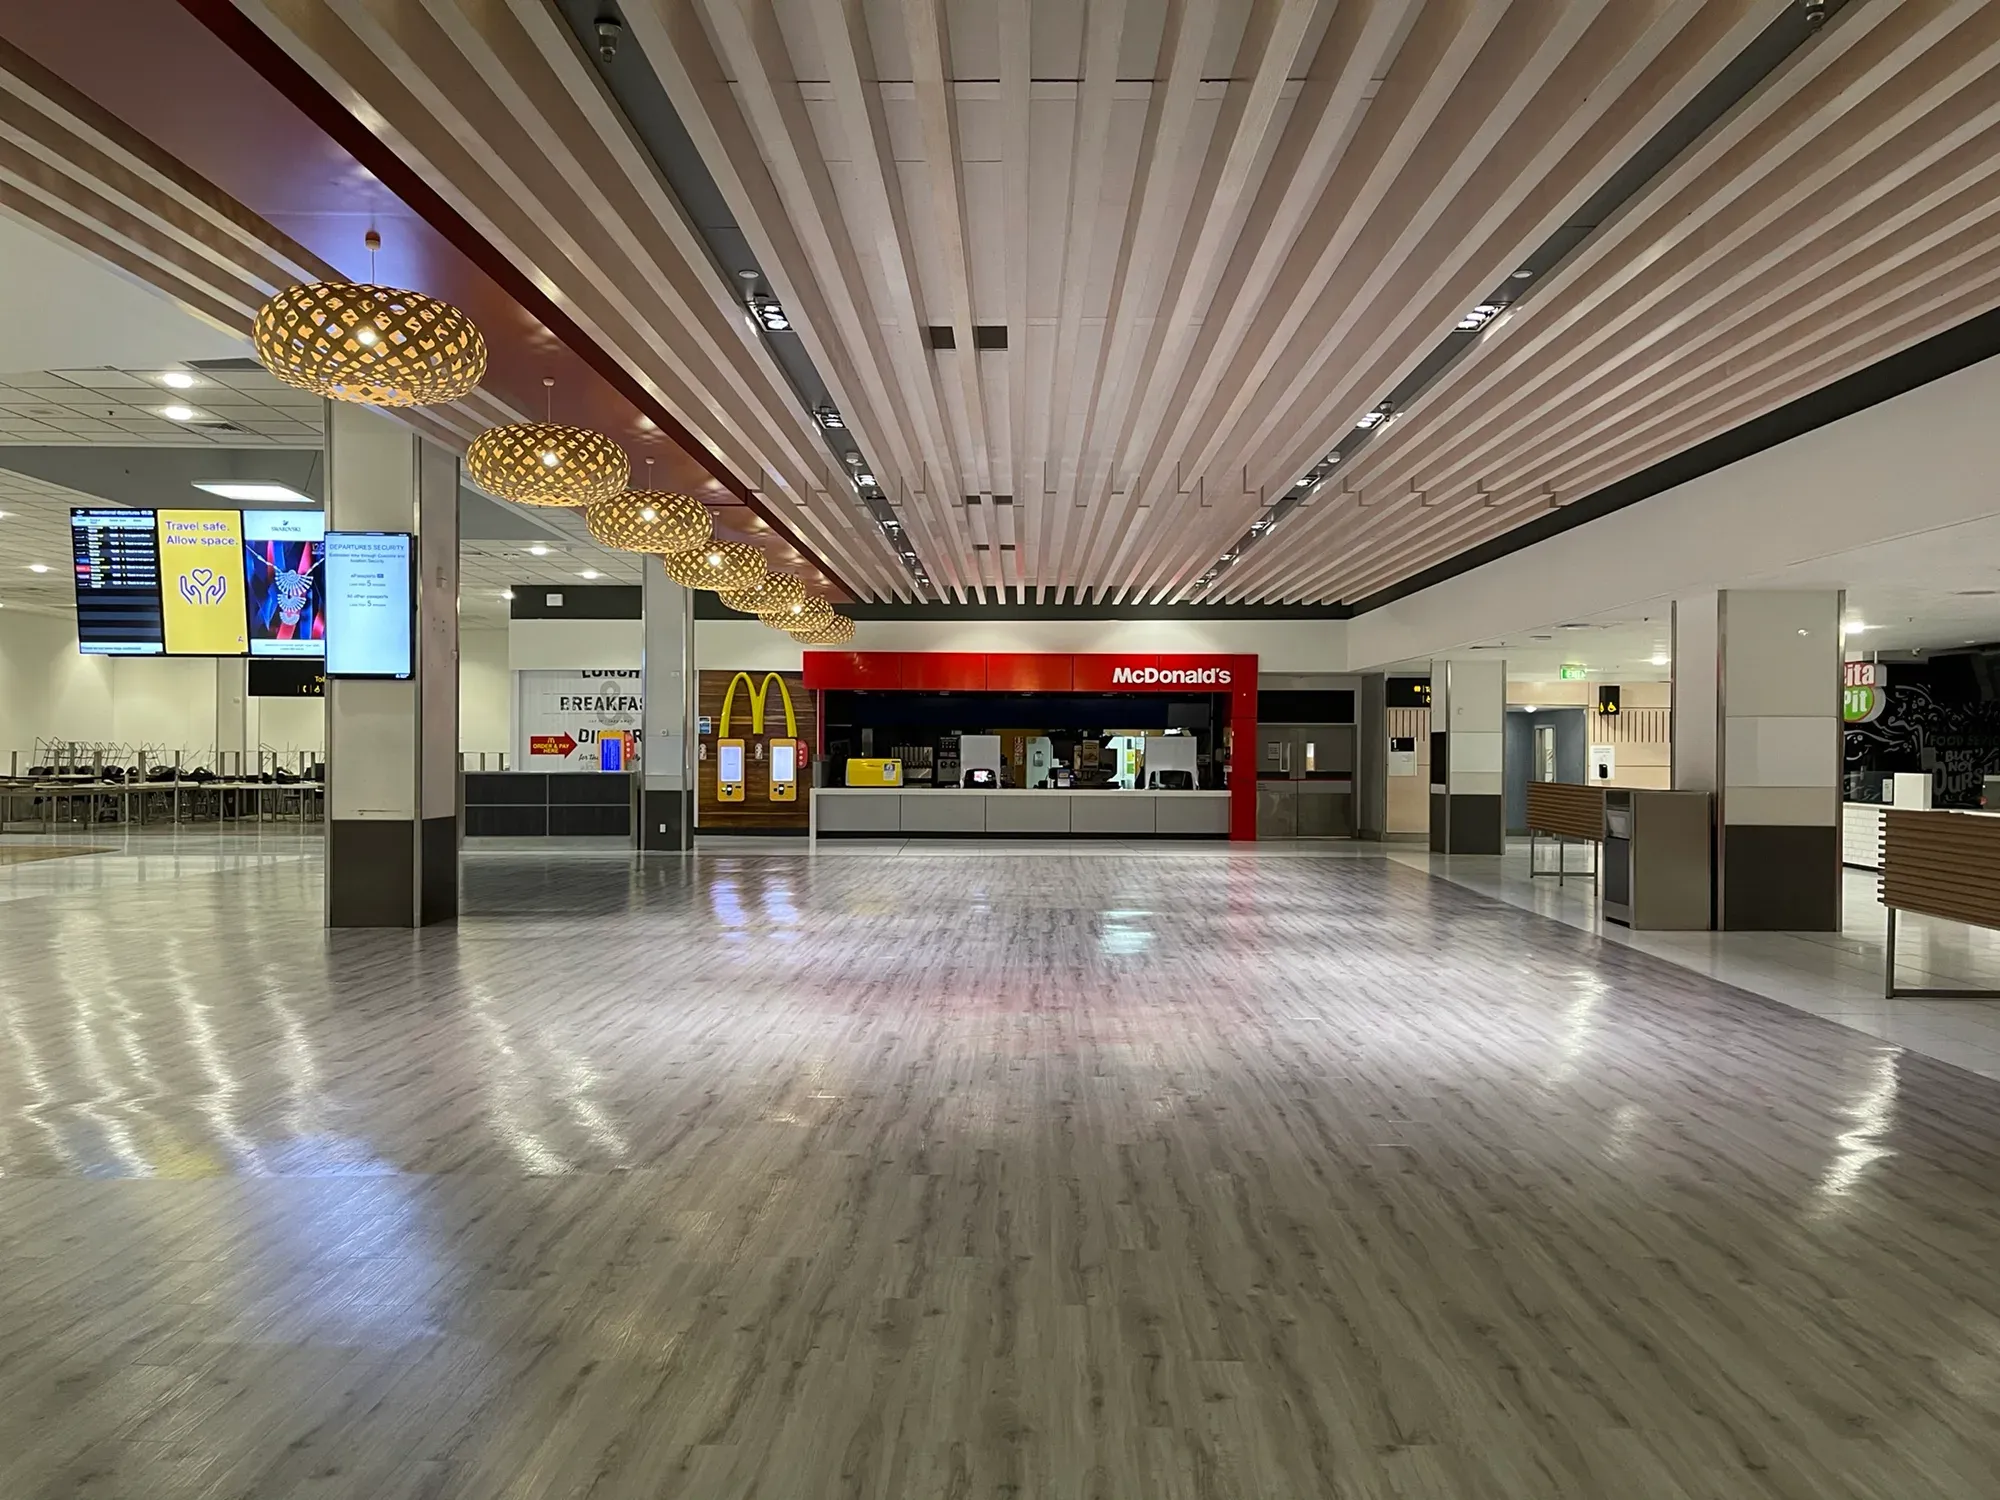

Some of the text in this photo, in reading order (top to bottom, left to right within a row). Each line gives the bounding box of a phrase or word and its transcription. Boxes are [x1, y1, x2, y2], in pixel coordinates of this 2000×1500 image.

[165, 521, 199, 531] Travel
[203, 521, 230, 531] safe.
[166, 535, 239, 547] Allow space.
[1112, 667, 1232, 684] McDonald's
[1844, 664, 1875, 686] ita
[1391, 739, 1397, 748] 1
[1945, 750, 1973, 763] BUT
[1948, 758, 1976, 772] NOT
